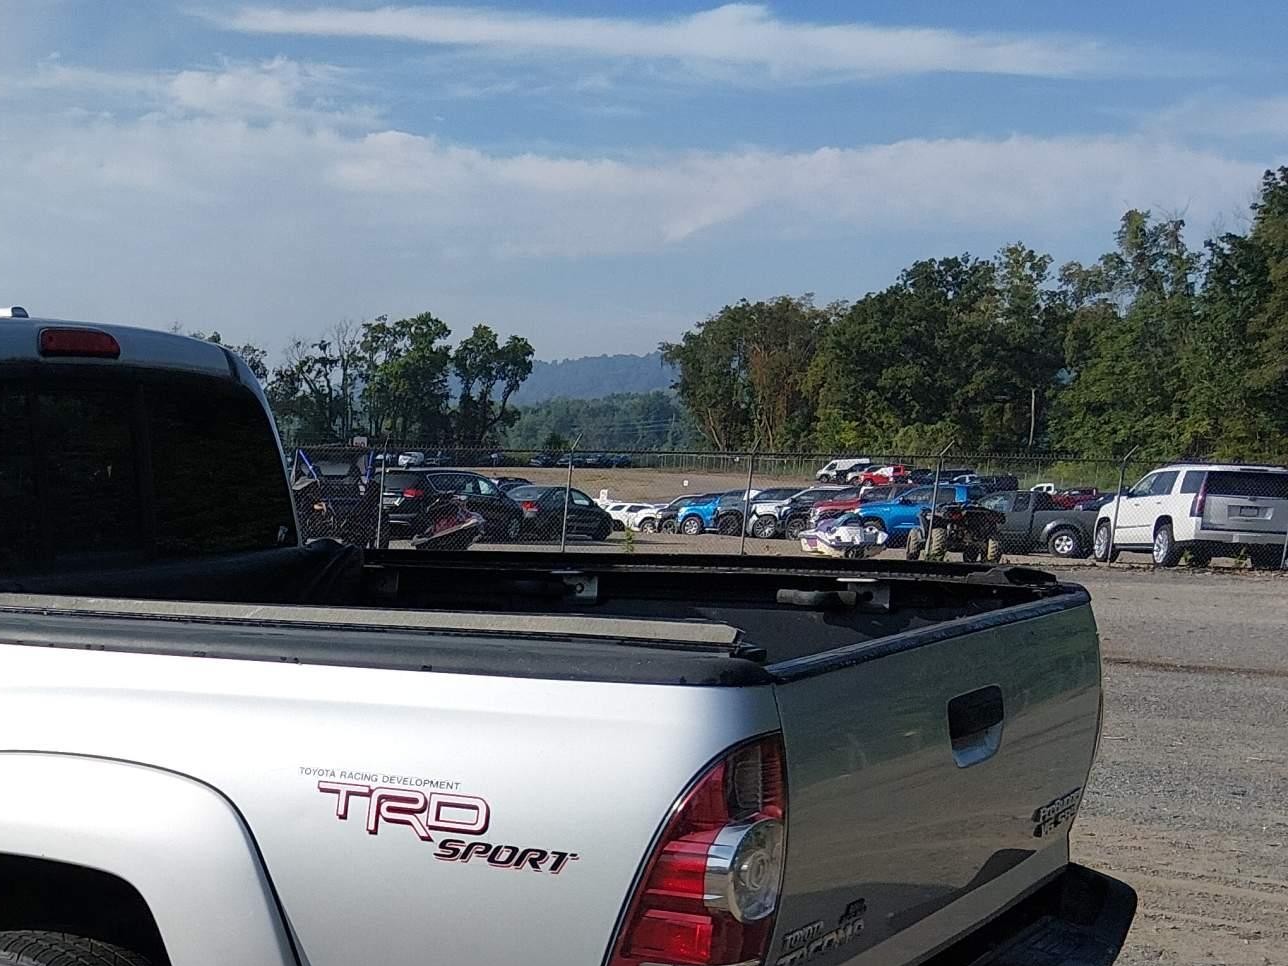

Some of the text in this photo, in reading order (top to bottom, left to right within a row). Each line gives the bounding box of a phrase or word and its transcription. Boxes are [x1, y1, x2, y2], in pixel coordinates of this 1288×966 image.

[299, 766, 461, 791] TOYOTA RACING DEVELOPMENT
[317, 780, 491, 842] TRD
[433, 837, 573, 875] SPORT
